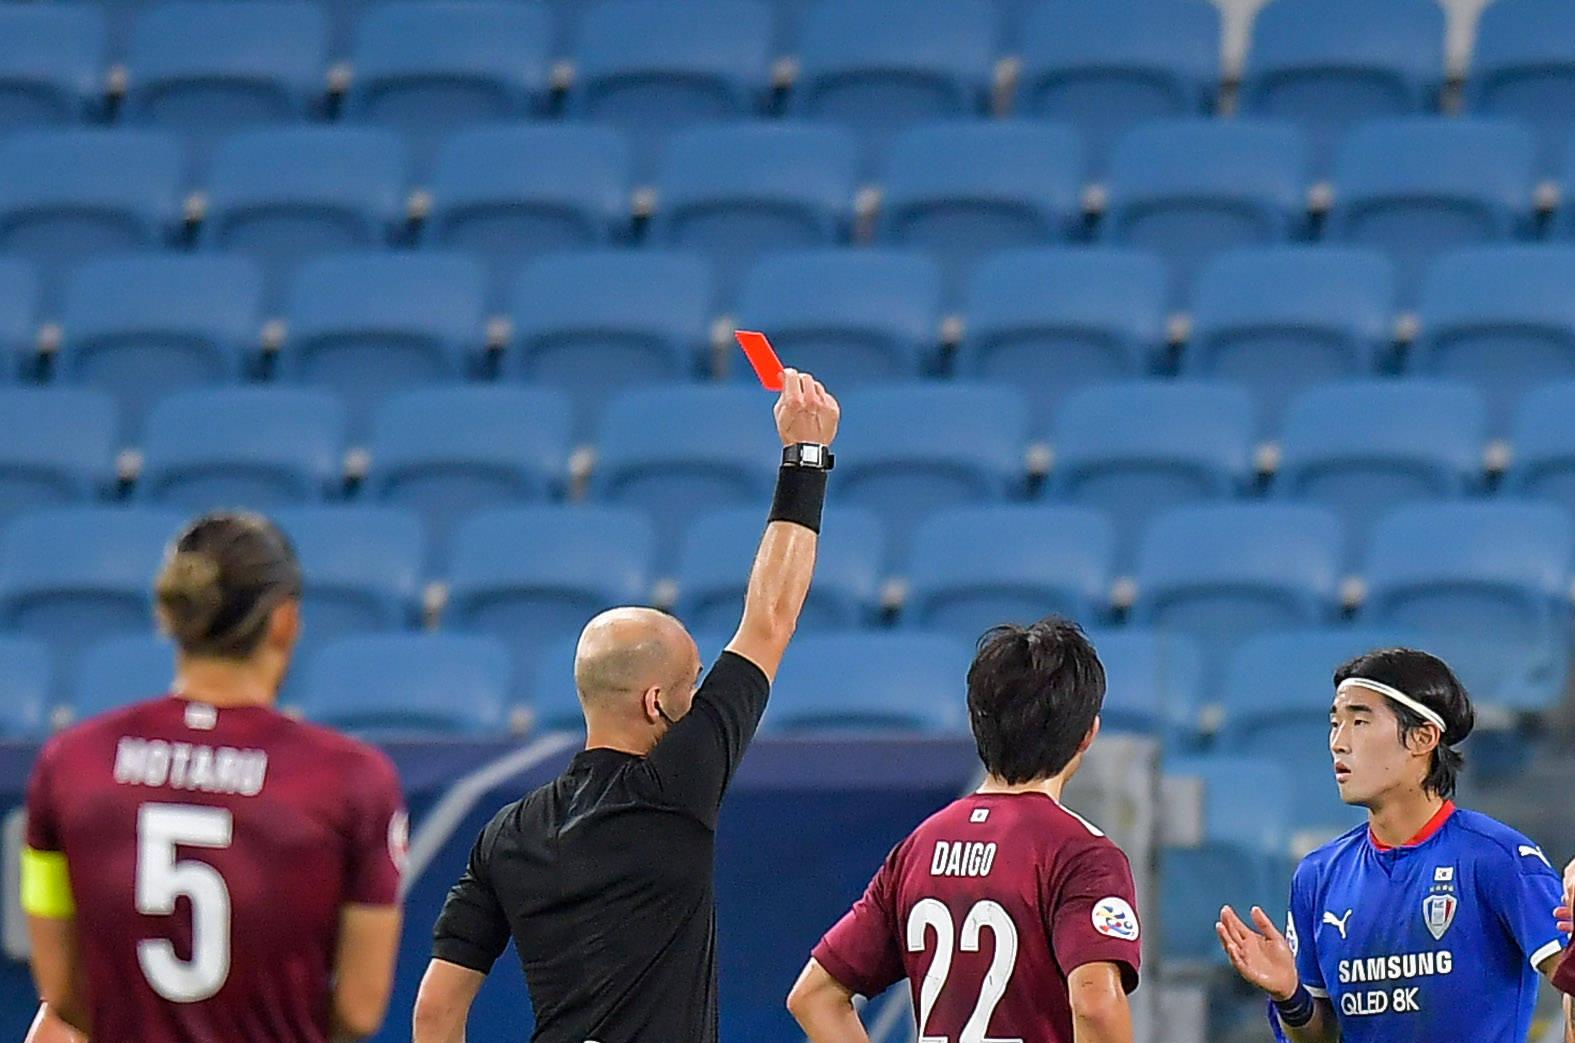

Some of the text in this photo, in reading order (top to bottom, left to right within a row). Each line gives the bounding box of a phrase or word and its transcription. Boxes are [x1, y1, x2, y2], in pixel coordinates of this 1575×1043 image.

[930, 841, 998, 877] DAIGO
[135, 801, 233, 1003] 5
[1338, 950, 1453, 983] SAMSUNG
[1340, 987, 1420, 1016] QLED 8K
